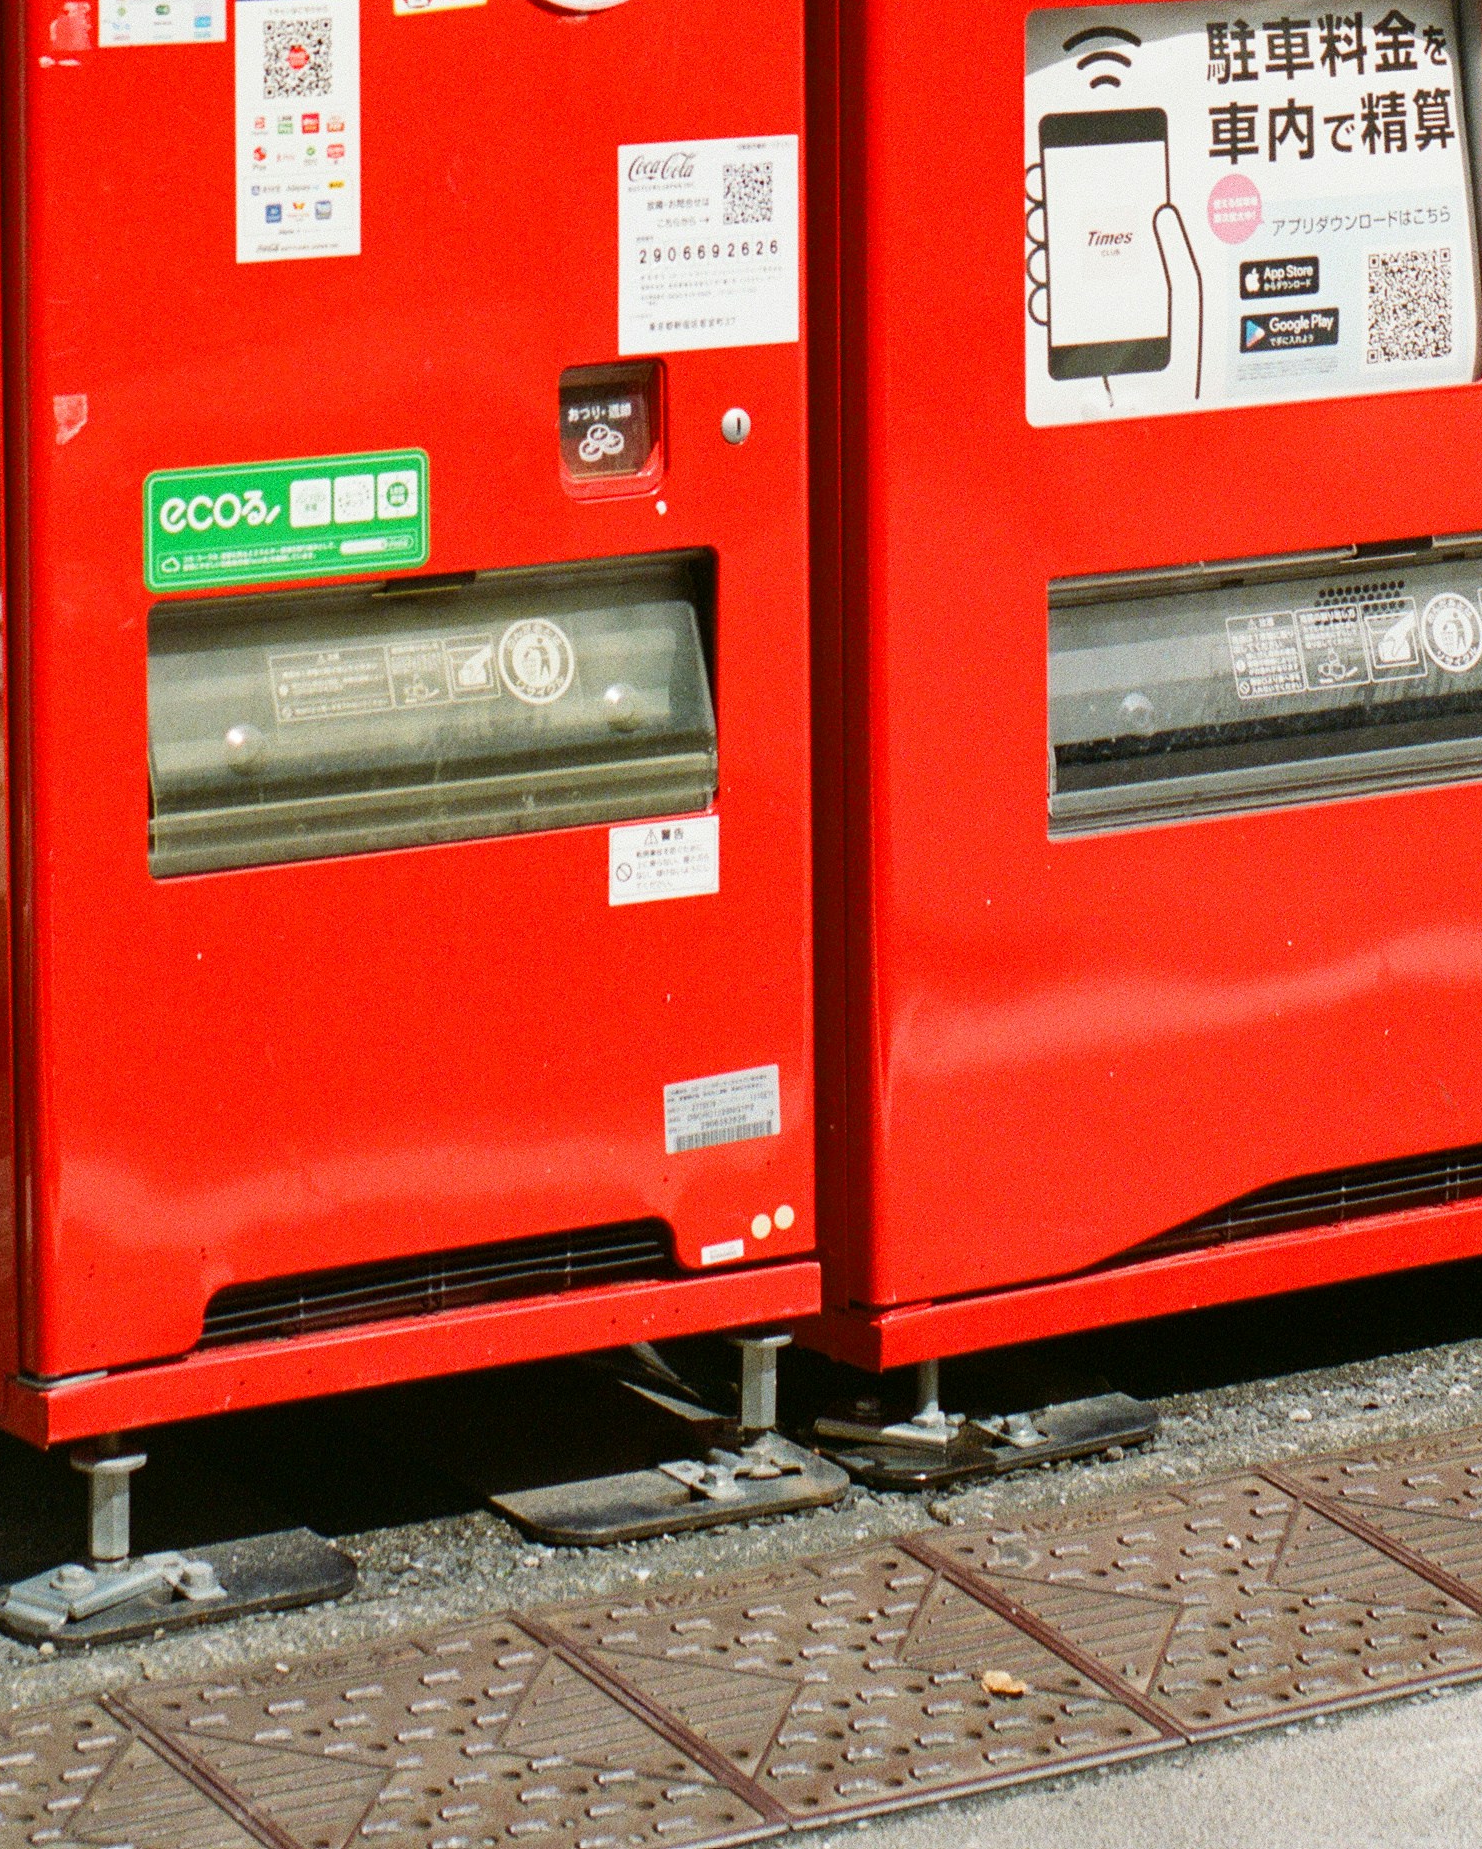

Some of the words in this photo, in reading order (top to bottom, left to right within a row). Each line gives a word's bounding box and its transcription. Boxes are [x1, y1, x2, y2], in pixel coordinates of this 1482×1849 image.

[1205, 8, 1449, 86] 駐車料金を
[1207, 87, 1456, 166] 車内で精算
[628, 151, 698, 183] Coca-Cola
[1271, 205, 1452, 238] アプリダウンロードはこちら
[1086, 228, 1133, 248] Times
[1263, 264, 1284, 283] App
[1285, 263, 1314, 279] Store
[1268, 315, 1308, 336] Google
[1310, 313, 1334, 334] Play
